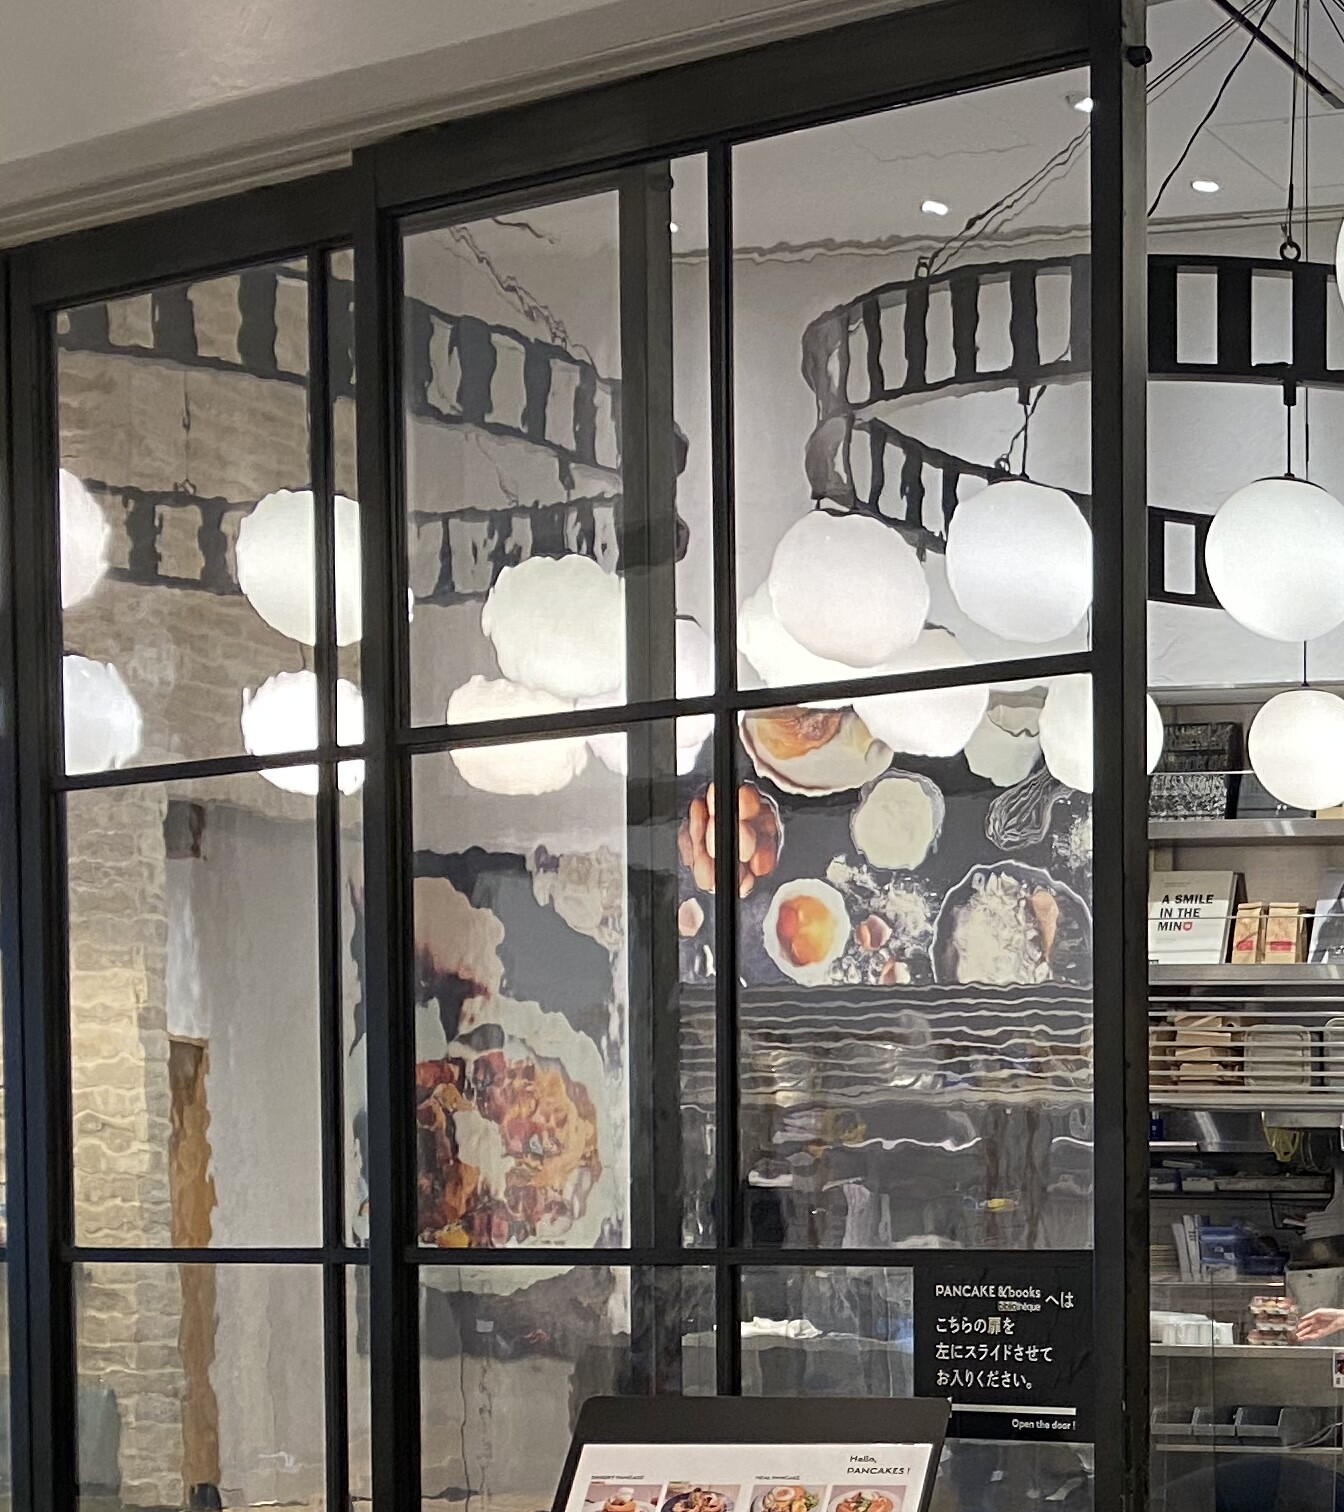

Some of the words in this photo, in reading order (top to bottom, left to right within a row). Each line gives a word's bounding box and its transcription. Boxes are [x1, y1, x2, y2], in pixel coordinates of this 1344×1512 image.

[1162, 895, 1169, 904] A
[1175, 894, 1214, 904] SMILE
[1160, 908, 1173, 918] IN
[1178, 908, 1201, 918] THE
[935, 1285, 995, 1297] PANCAKE
[1045, 1292, 1074, 1309] へは
[936, 1317, 1015, 1335] こちらの扉を
[936, 1343, 1052, 1362] 左にスライドさせて
[937, 1370, 1032, 1389] お入りください。
[1012, 1419, 1034, 1429] Open
[1036, 1420, 1050, 1429] the
[847, 1467, 905, 1475] PANCAKES
